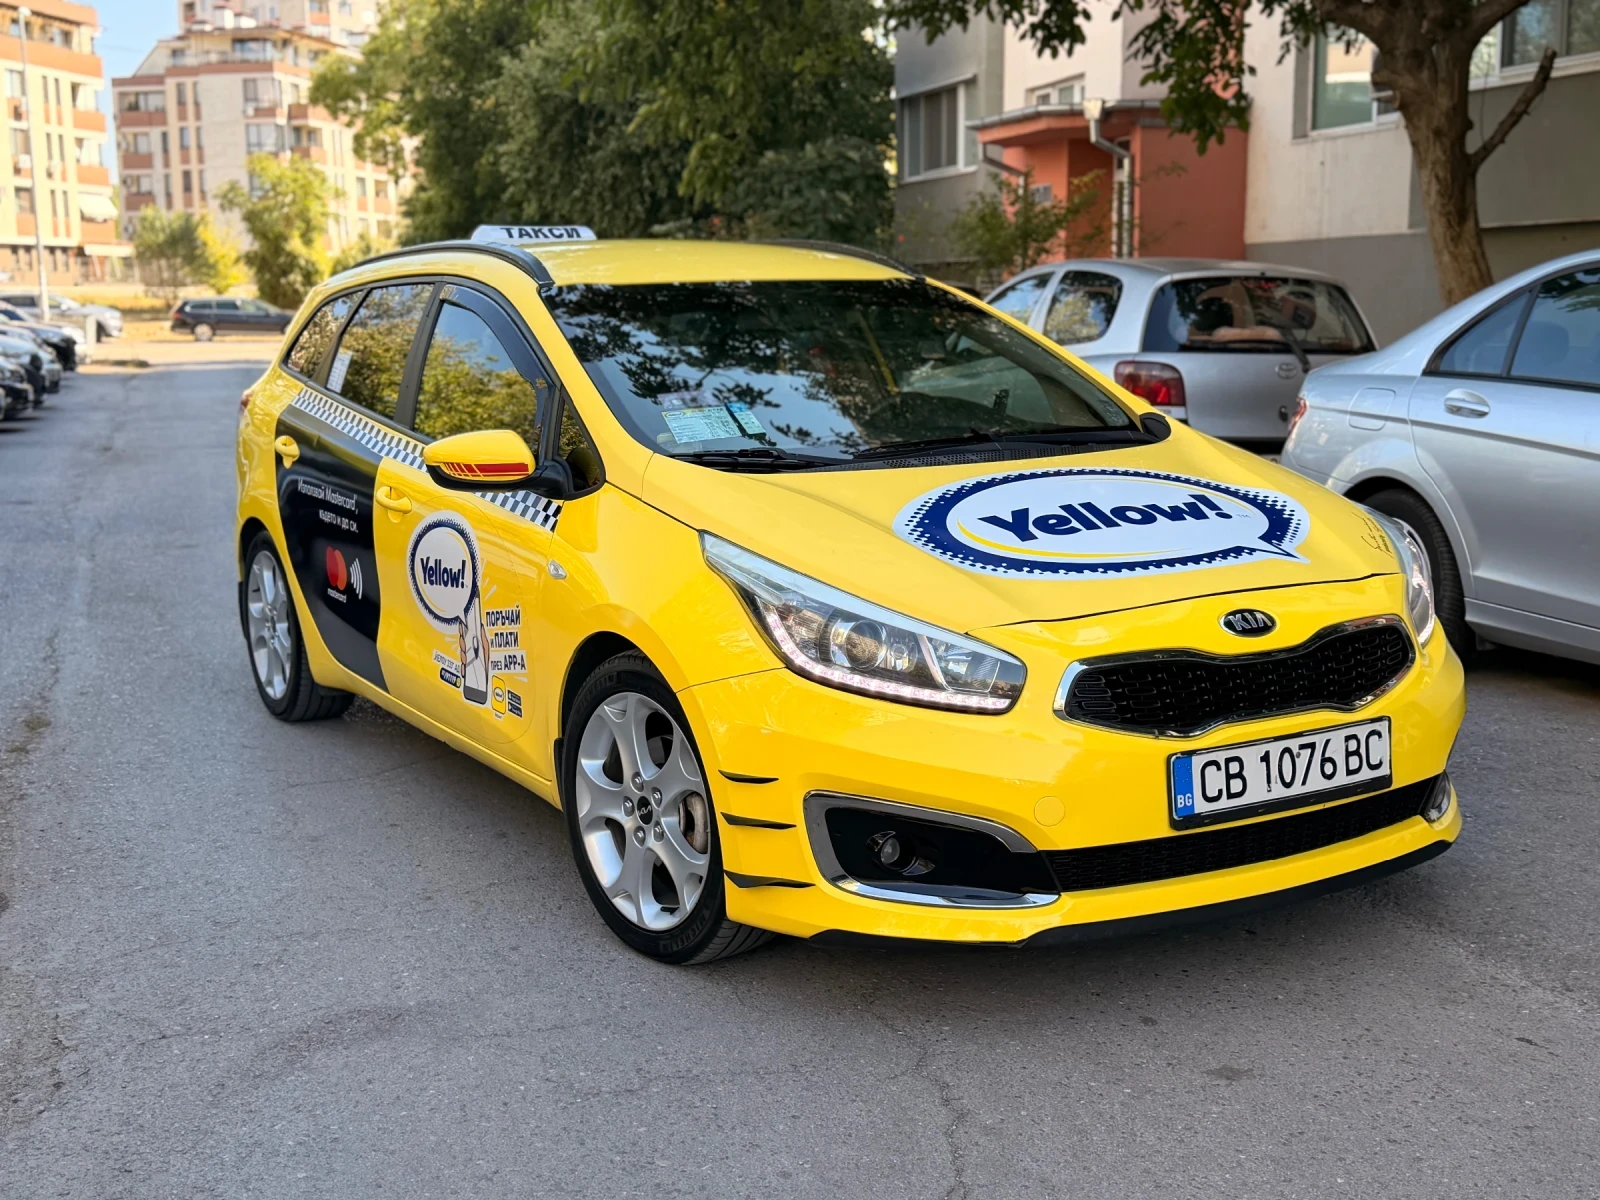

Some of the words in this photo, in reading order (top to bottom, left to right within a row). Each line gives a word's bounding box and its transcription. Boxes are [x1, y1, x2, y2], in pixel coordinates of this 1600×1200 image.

[500, 227, 581, 238] ТАКСИ
[977, 494, 1233, 542] Yellow!
[420, 556, 466, 589] Yellow!
[486, 603, 520, 627] ПОРЪЧАЙ
[1228, 611, 1272, 631] KIA
[494, 631, 518, 648] ПЛАТИ
[490, 660, 502, 670] ПРЕЗ
[1200, 756, 1247, 803] CB
[1259, 738, 1338, 793] 1076
[1344, 729, 1384, 776] BC
[1177, 793, 1193, 808] BG
